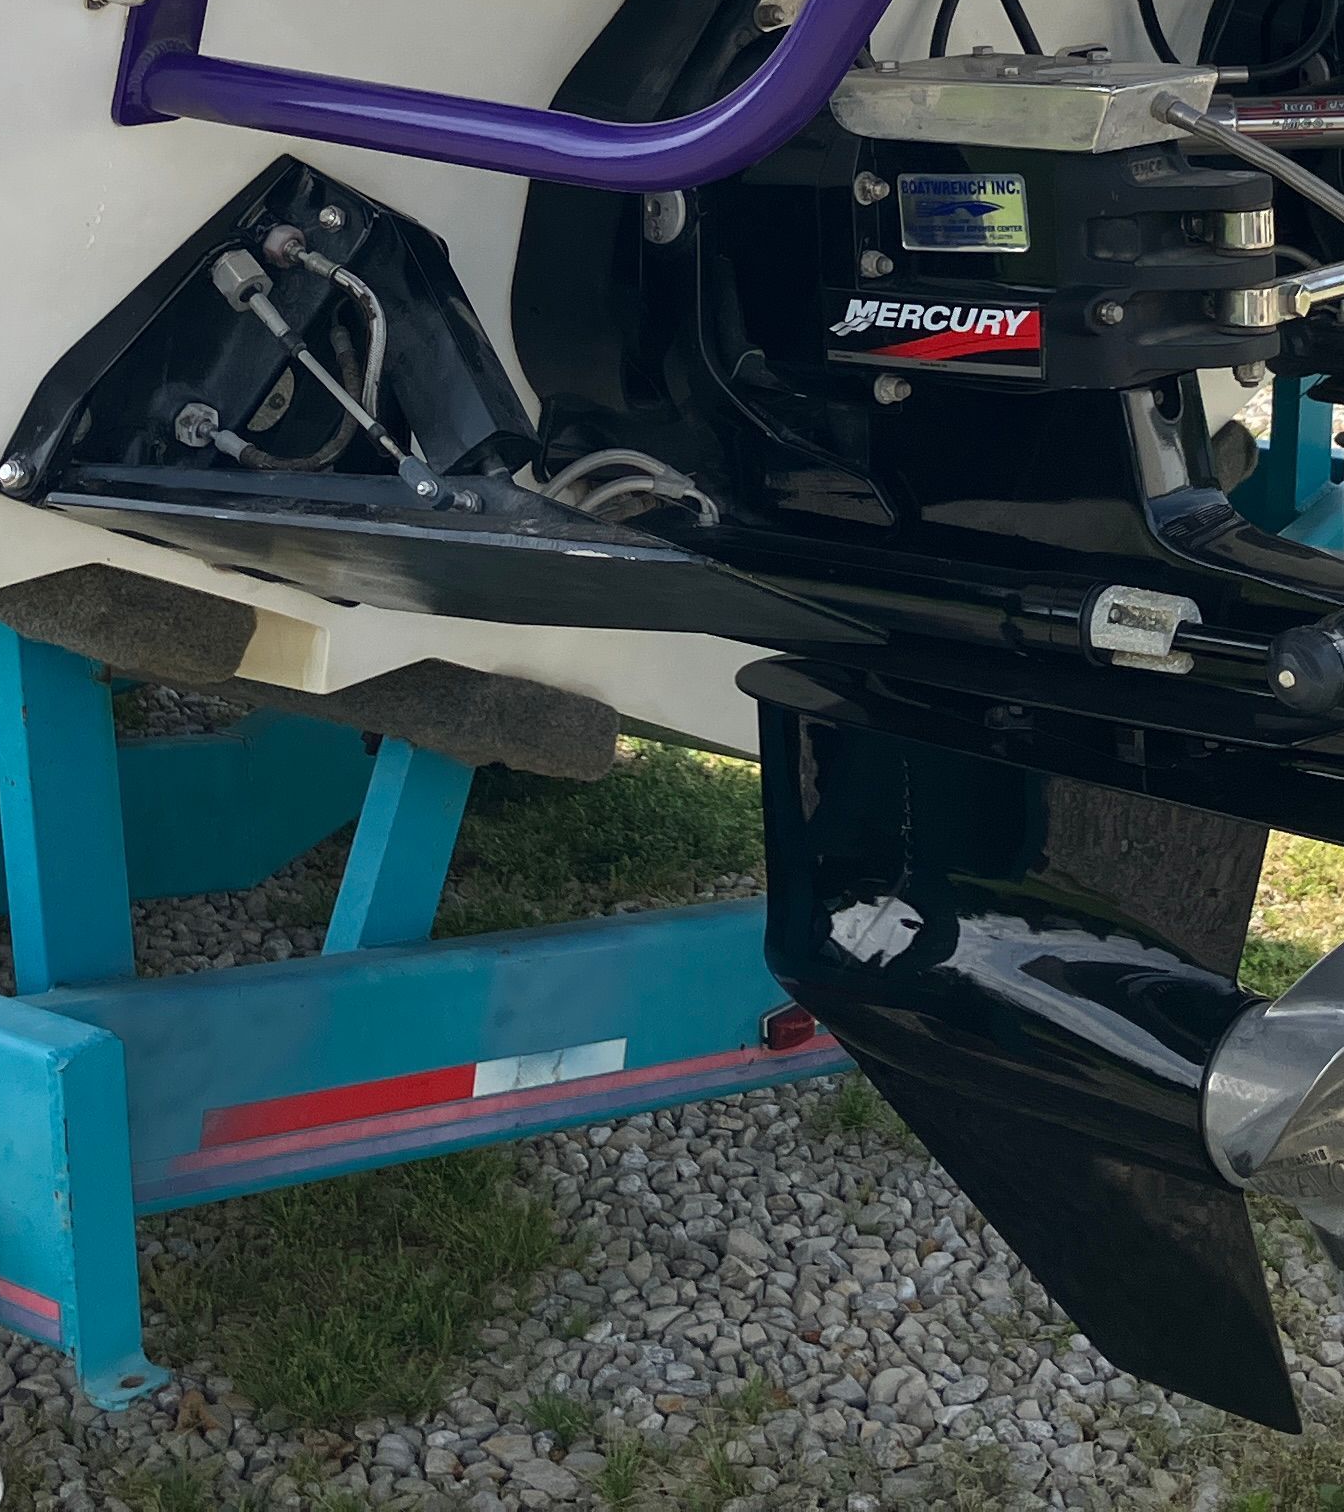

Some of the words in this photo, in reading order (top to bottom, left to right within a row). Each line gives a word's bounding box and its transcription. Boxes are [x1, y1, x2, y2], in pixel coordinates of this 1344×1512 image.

[902, 179, 987, 196] BOATWRENCH
[991, 179, 1021, 195] INC.
[829, 299, 1031, 336] MERCURY
